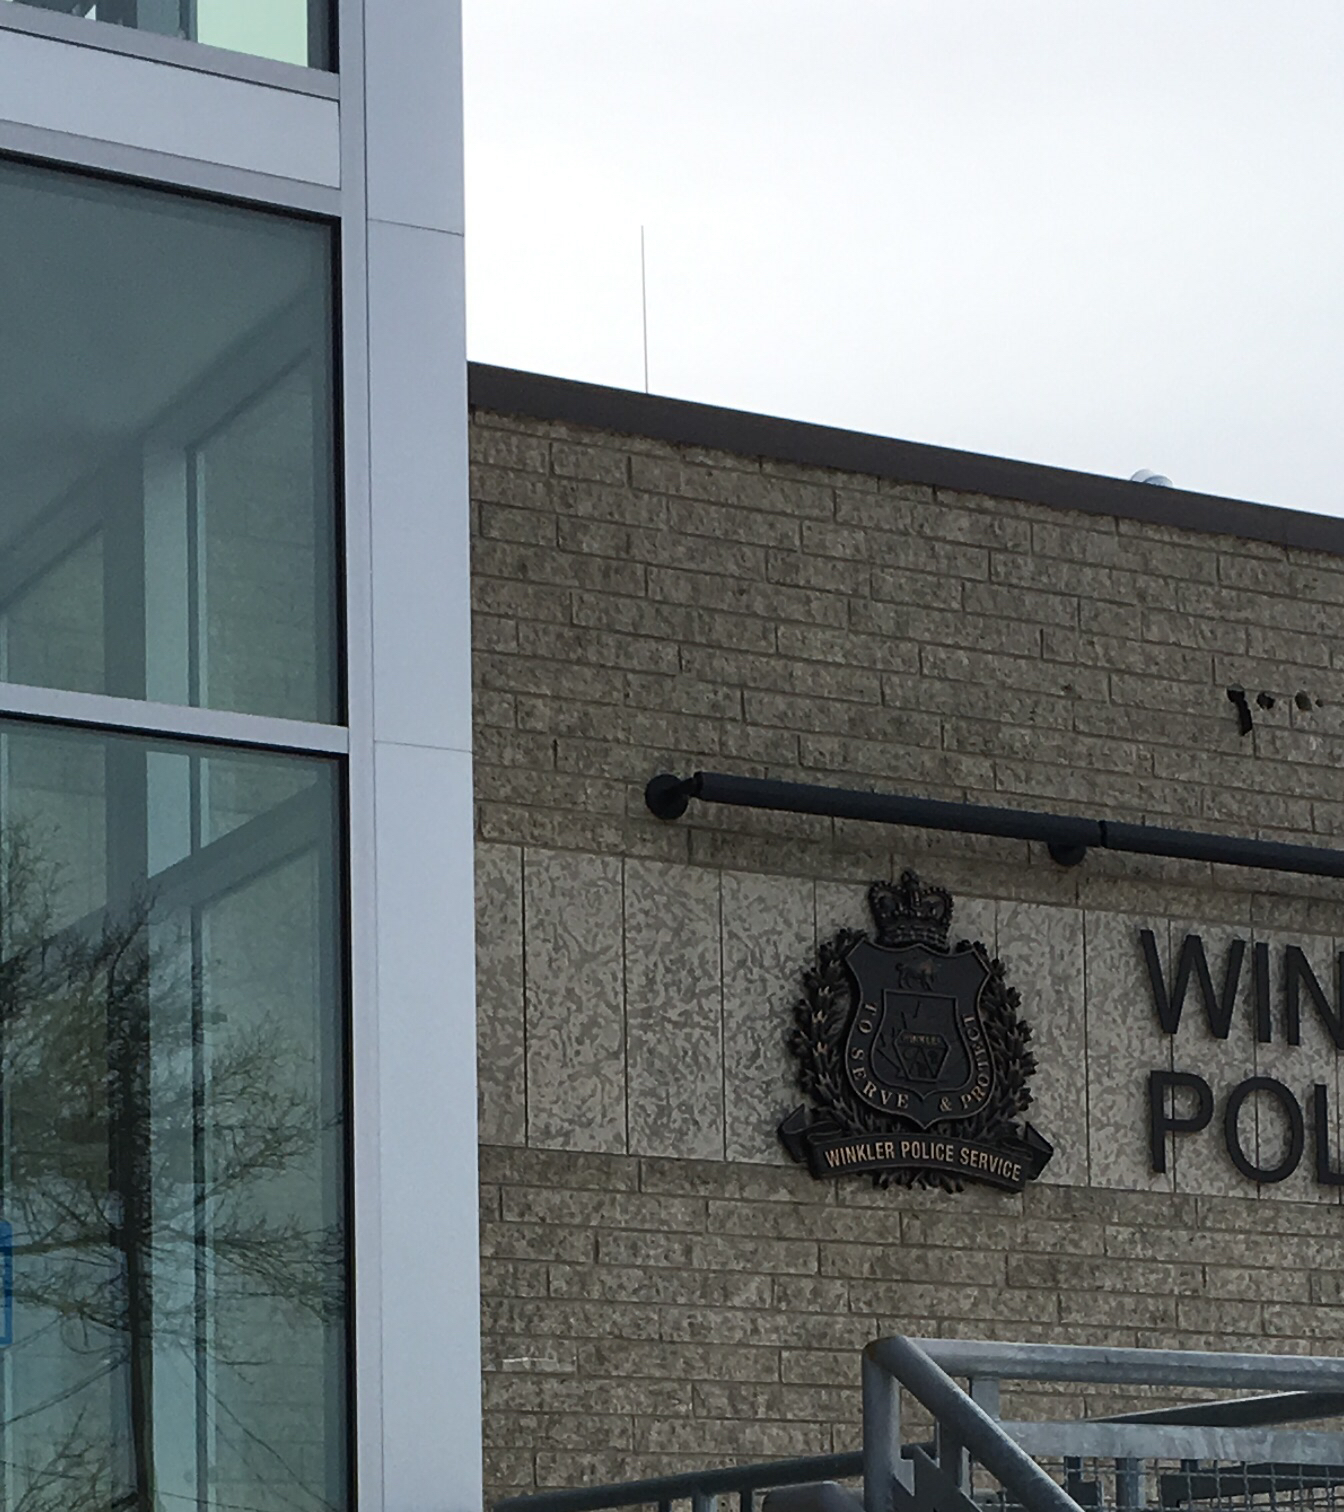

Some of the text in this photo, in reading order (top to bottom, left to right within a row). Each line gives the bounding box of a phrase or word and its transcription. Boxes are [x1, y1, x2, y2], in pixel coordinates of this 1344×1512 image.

[858, 1002, 878, 1034] TO
[851, 1047, 910, 1109] SERVE
[939, 1096, 953, 1112] &
[825, 1141, 1022, 1182] WINKLER POLICE SERVICE
